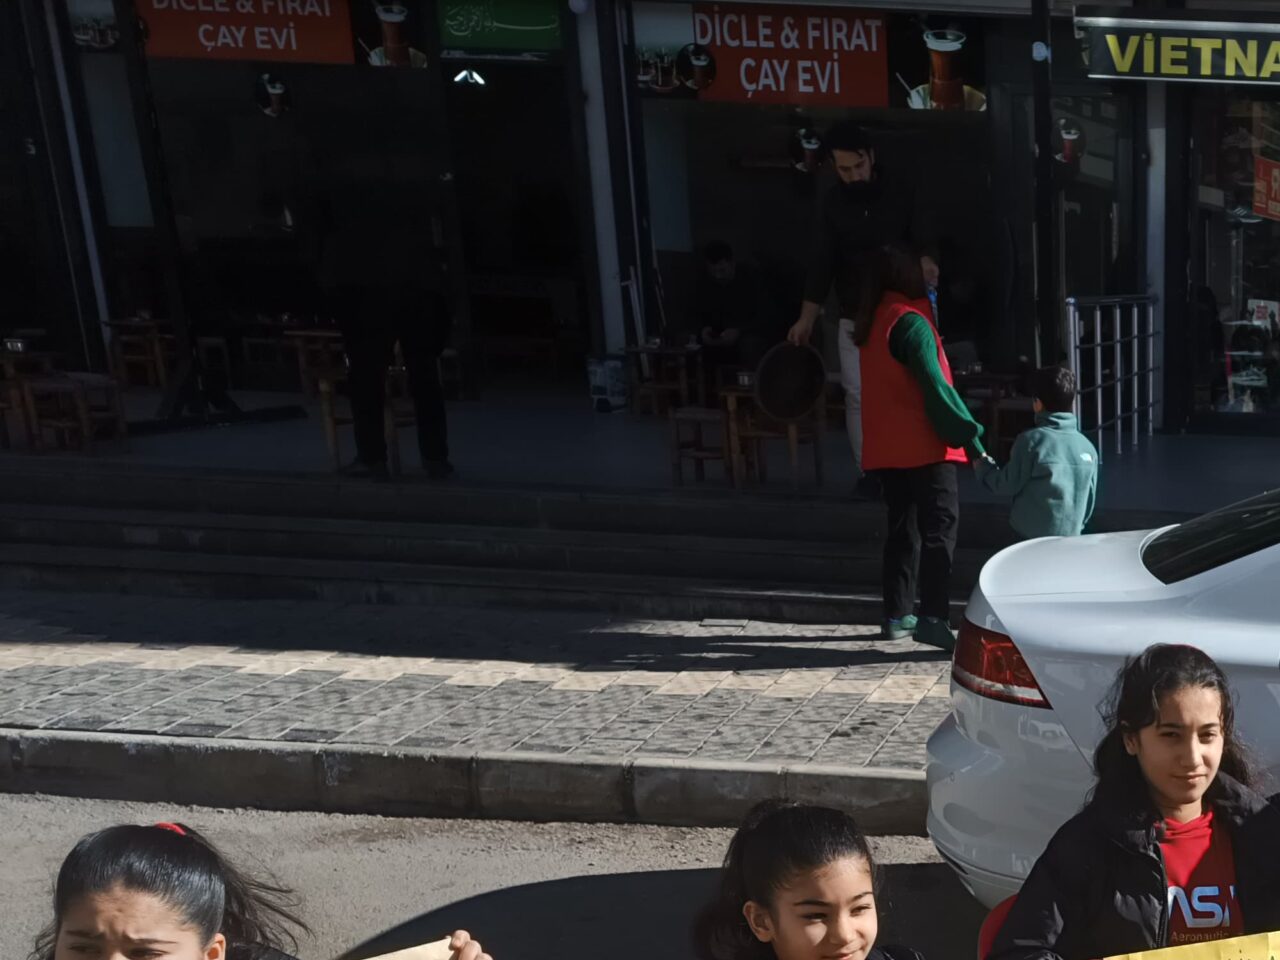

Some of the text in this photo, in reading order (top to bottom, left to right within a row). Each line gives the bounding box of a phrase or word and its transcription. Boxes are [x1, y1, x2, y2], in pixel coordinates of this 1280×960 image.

[198, 21, 297, 52] ÇAY EVİ
[694, 4, 882, 53] DİCLE & FIRAT
[739, 52, 840, 99] ÇAY EVİ
